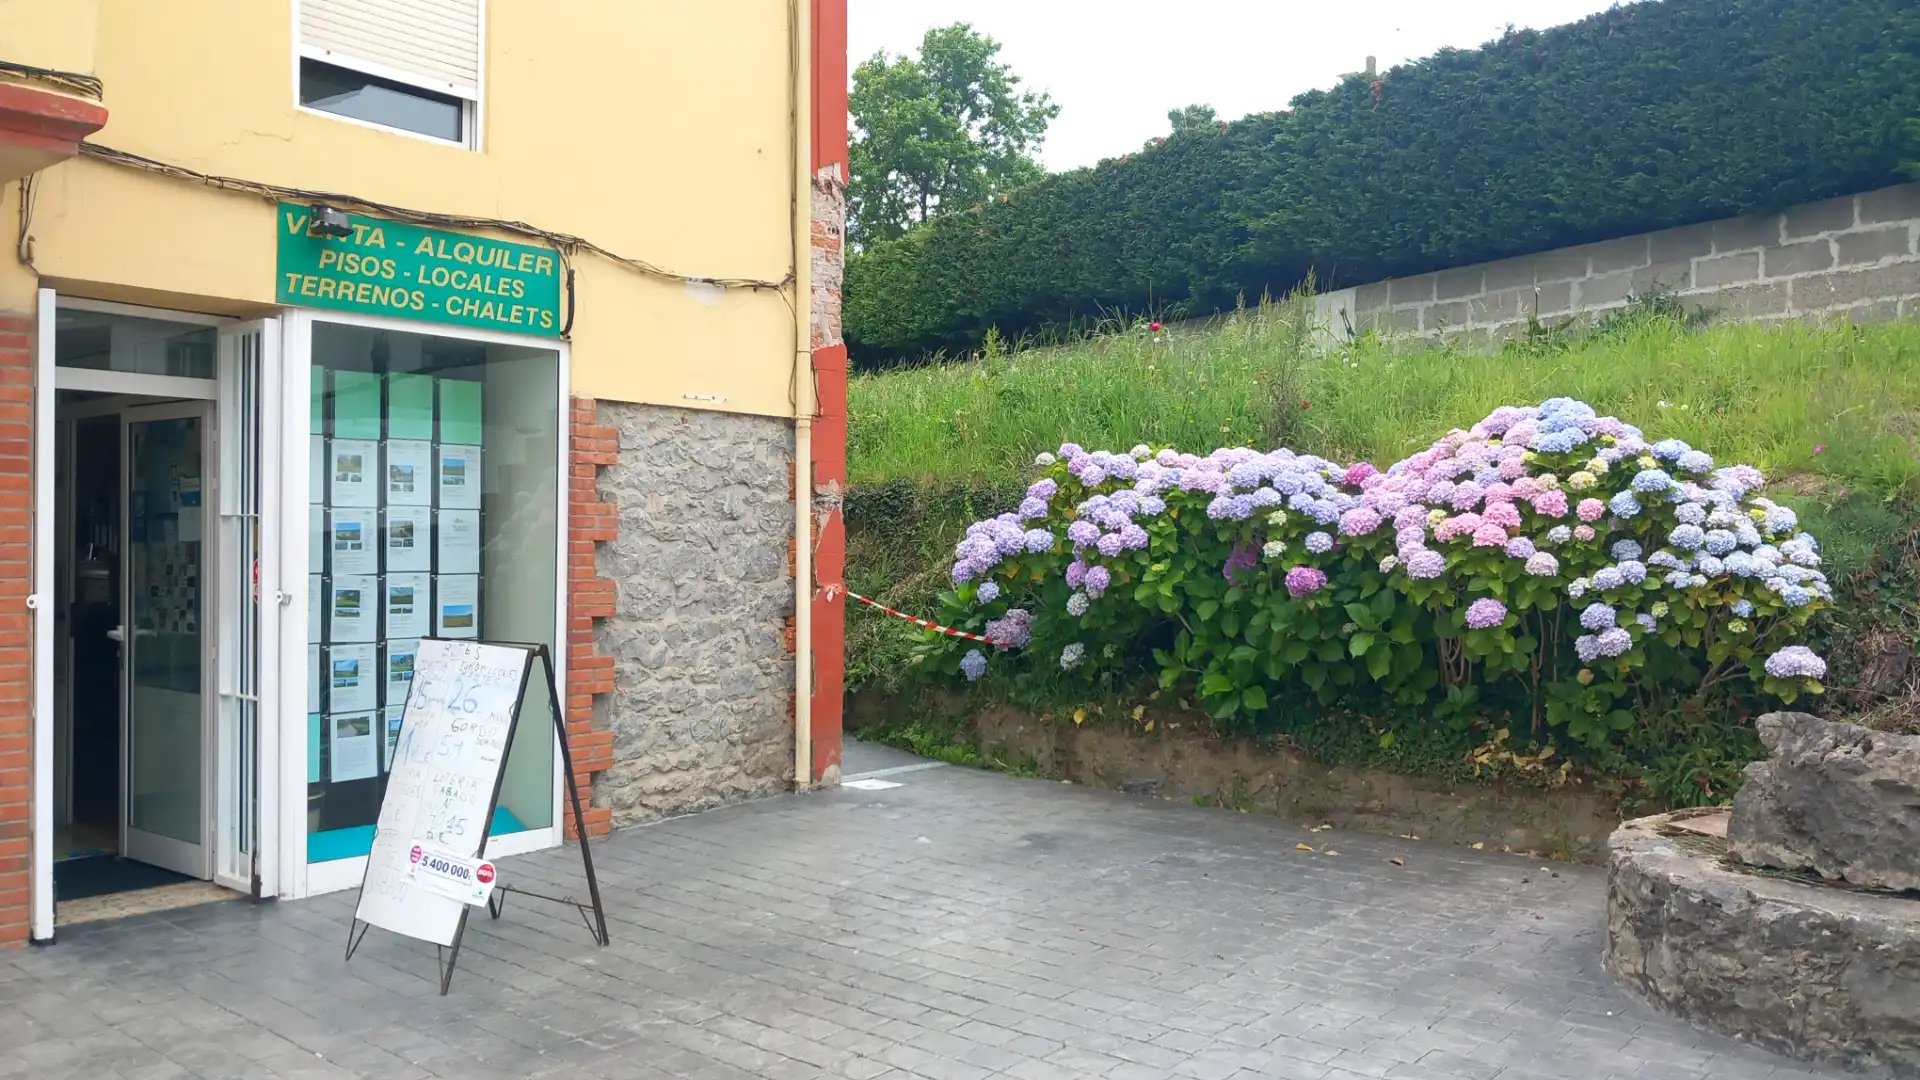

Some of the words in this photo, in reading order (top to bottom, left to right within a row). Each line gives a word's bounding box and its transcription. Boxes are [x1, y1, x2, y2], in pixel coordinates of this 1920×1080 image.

[286, 212, 385, 249] VTA
[414, 236, 553, 276] ALQUILER
[319, 249, 396, 279] PISOS
[418, 264, 525, 298] LOCALES
[286, 273, 425, 311] TERRENOS
[446, 295, 553, 329] CHALETS
[447, 677, 482, 714] 26
